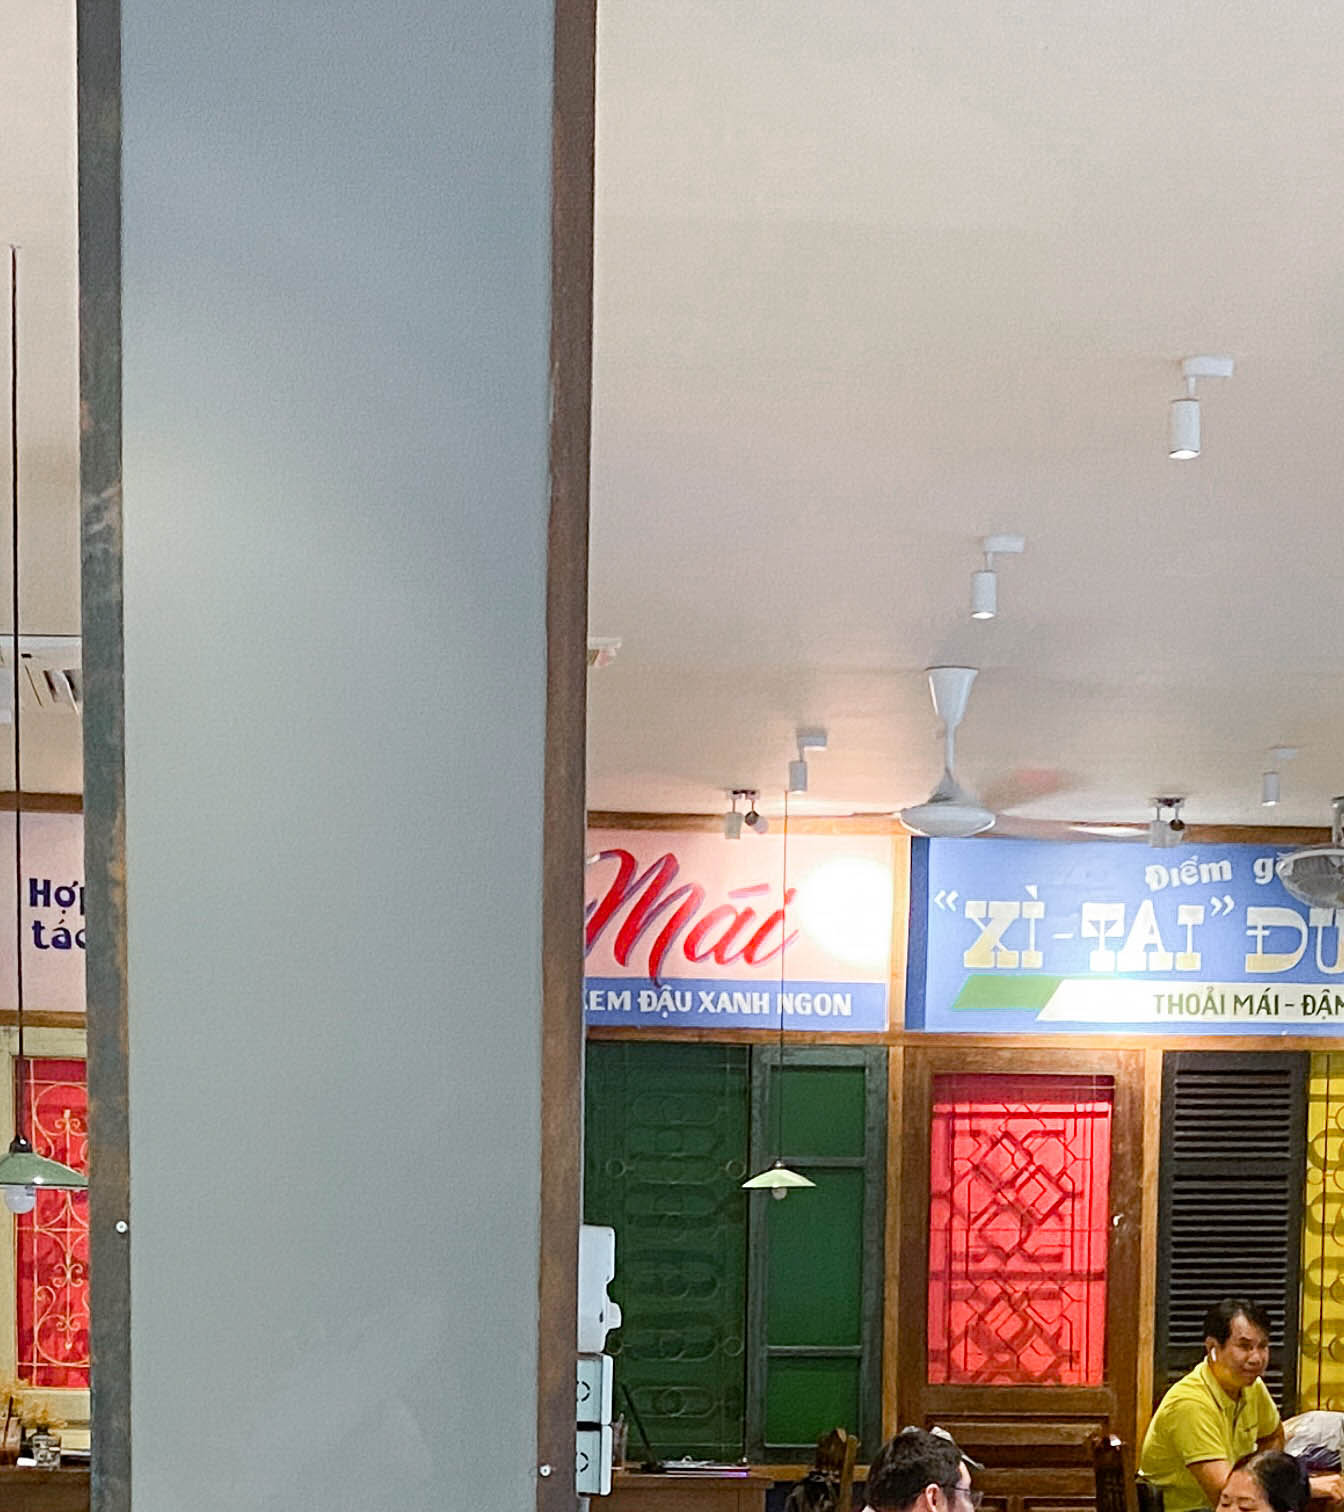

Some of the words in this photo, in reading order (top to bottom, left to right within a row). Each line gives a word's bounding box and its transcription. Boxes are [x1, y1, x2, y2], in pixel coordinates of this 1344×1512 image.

[638, 984, 692, 1018] ĐẬU
[697, 991, 770, 1014] XANH
[776, 993, 853, 1016] NGON
[1233, 987, 1280, 1016] MÁI
